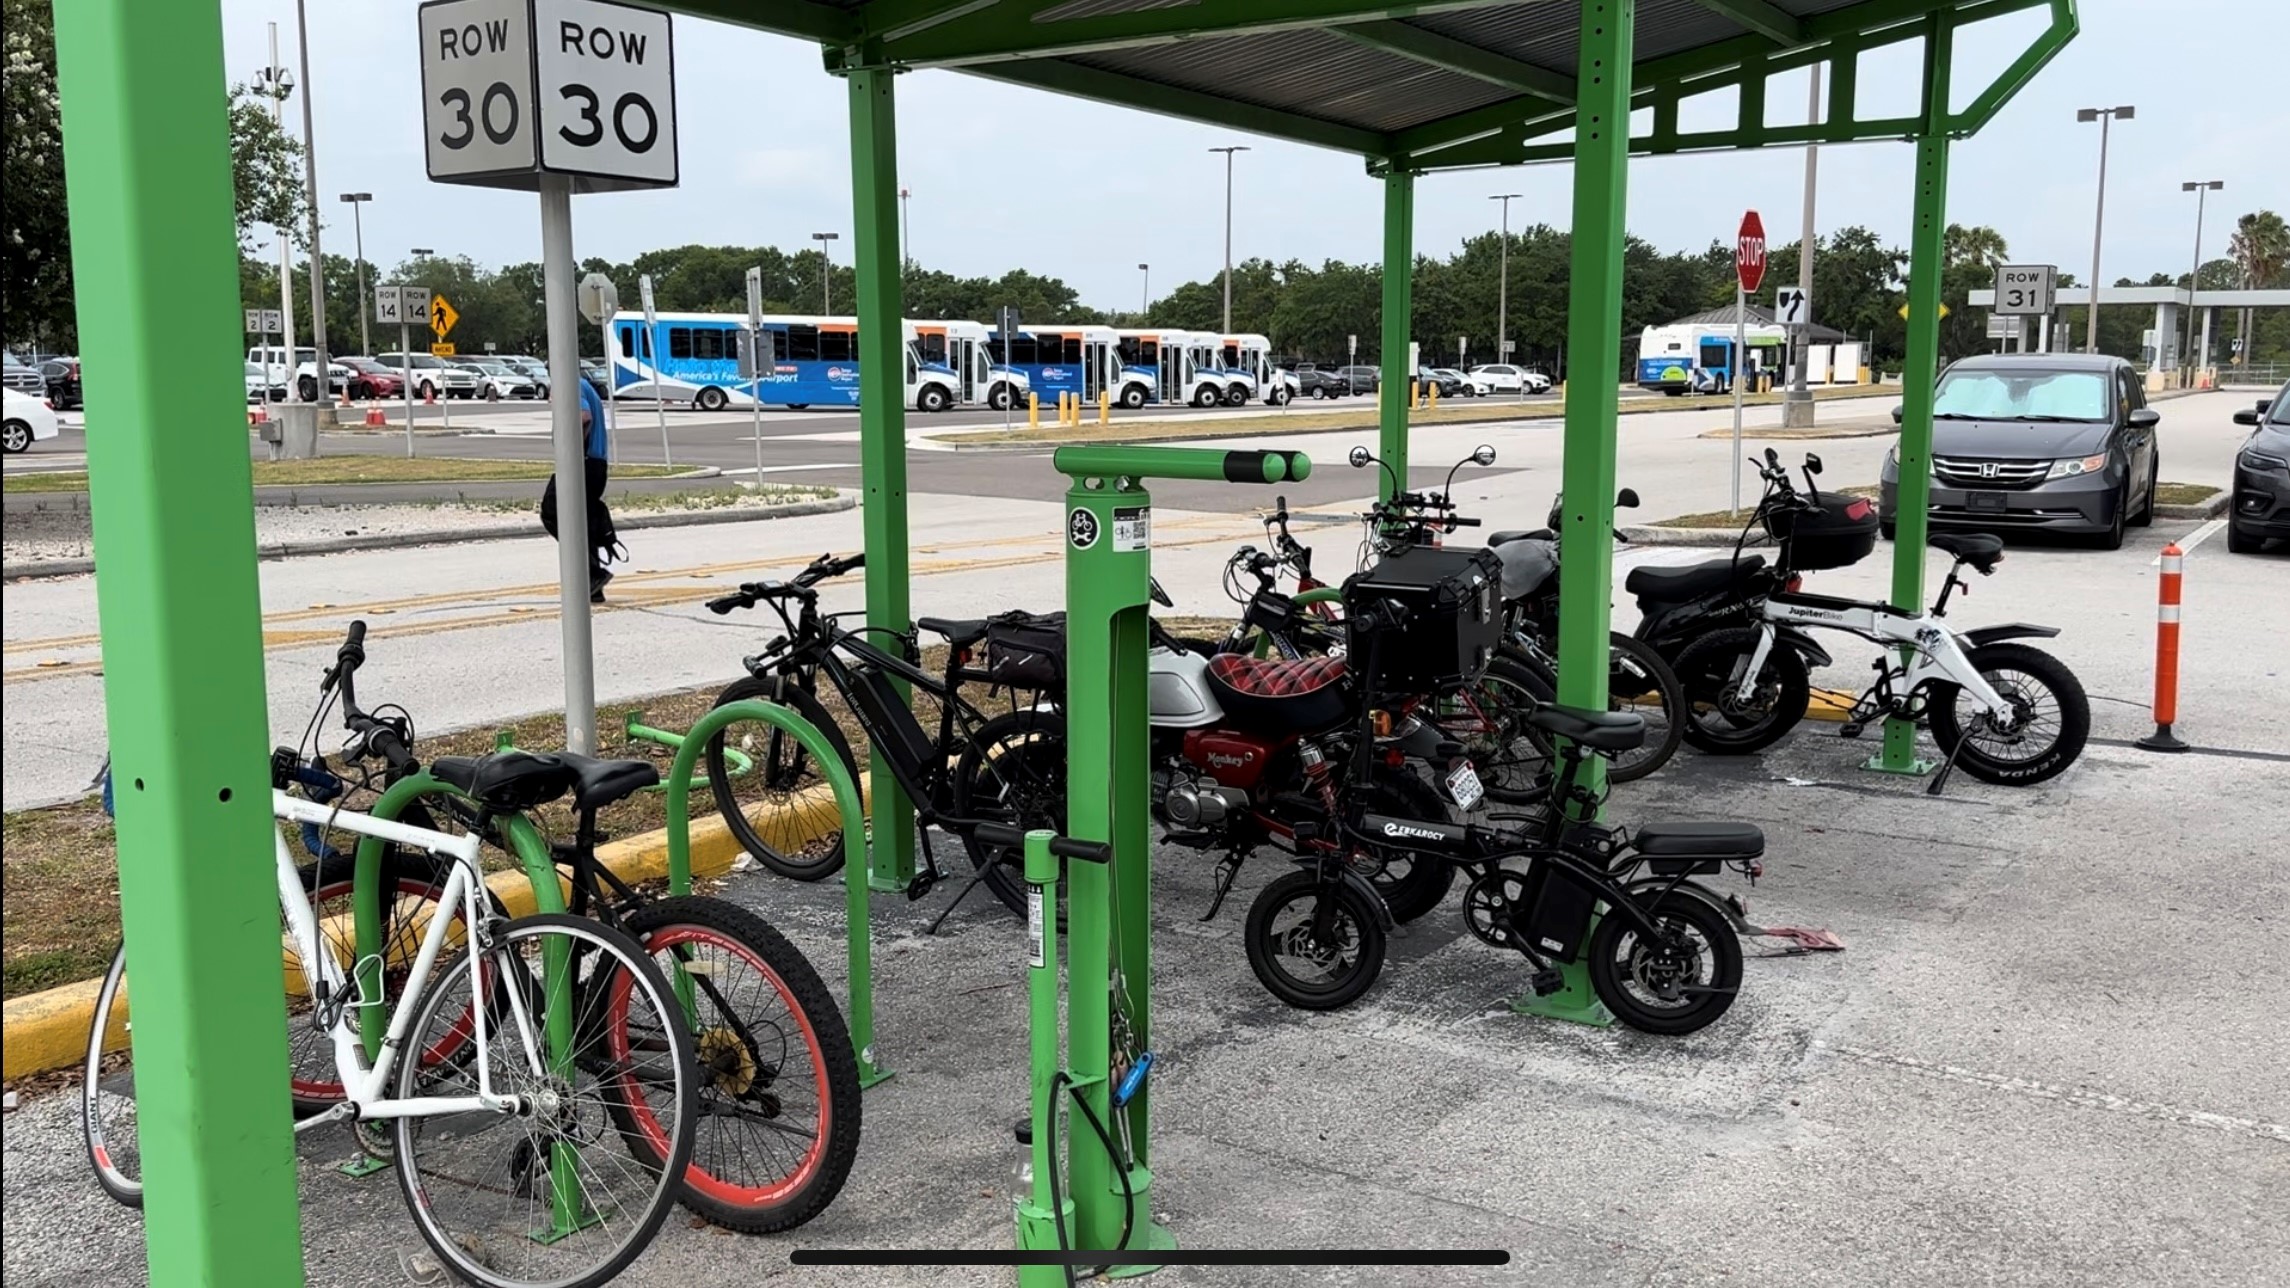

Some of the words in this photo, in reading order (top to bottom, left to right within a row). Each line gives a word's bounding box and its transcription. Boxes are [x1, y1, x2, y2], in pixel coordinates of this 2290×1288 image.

[439, 19, 508, 60] ROW
[560, 21, 647, 65] ROW
[440, 82, 519, 150] 30
[559, 83, 658, 154] 30
[1739, 236, 1763, 266] STOP
[2005, 273, 2039, 283] ROW
[379, 291, 397, 299] ROW
[406, 291, 426, 299] ROW
[2007, 289, 2036, 307] 31
[381, 304, 396, 318] 14
[409, 304, 426, 318] 14
[251, 320, 257, 330] 2
[268, 320, 276, 330] 2
[1207, 752, 1243, 768] Monkey
[89, 1096, 98, 1134] GIANT
